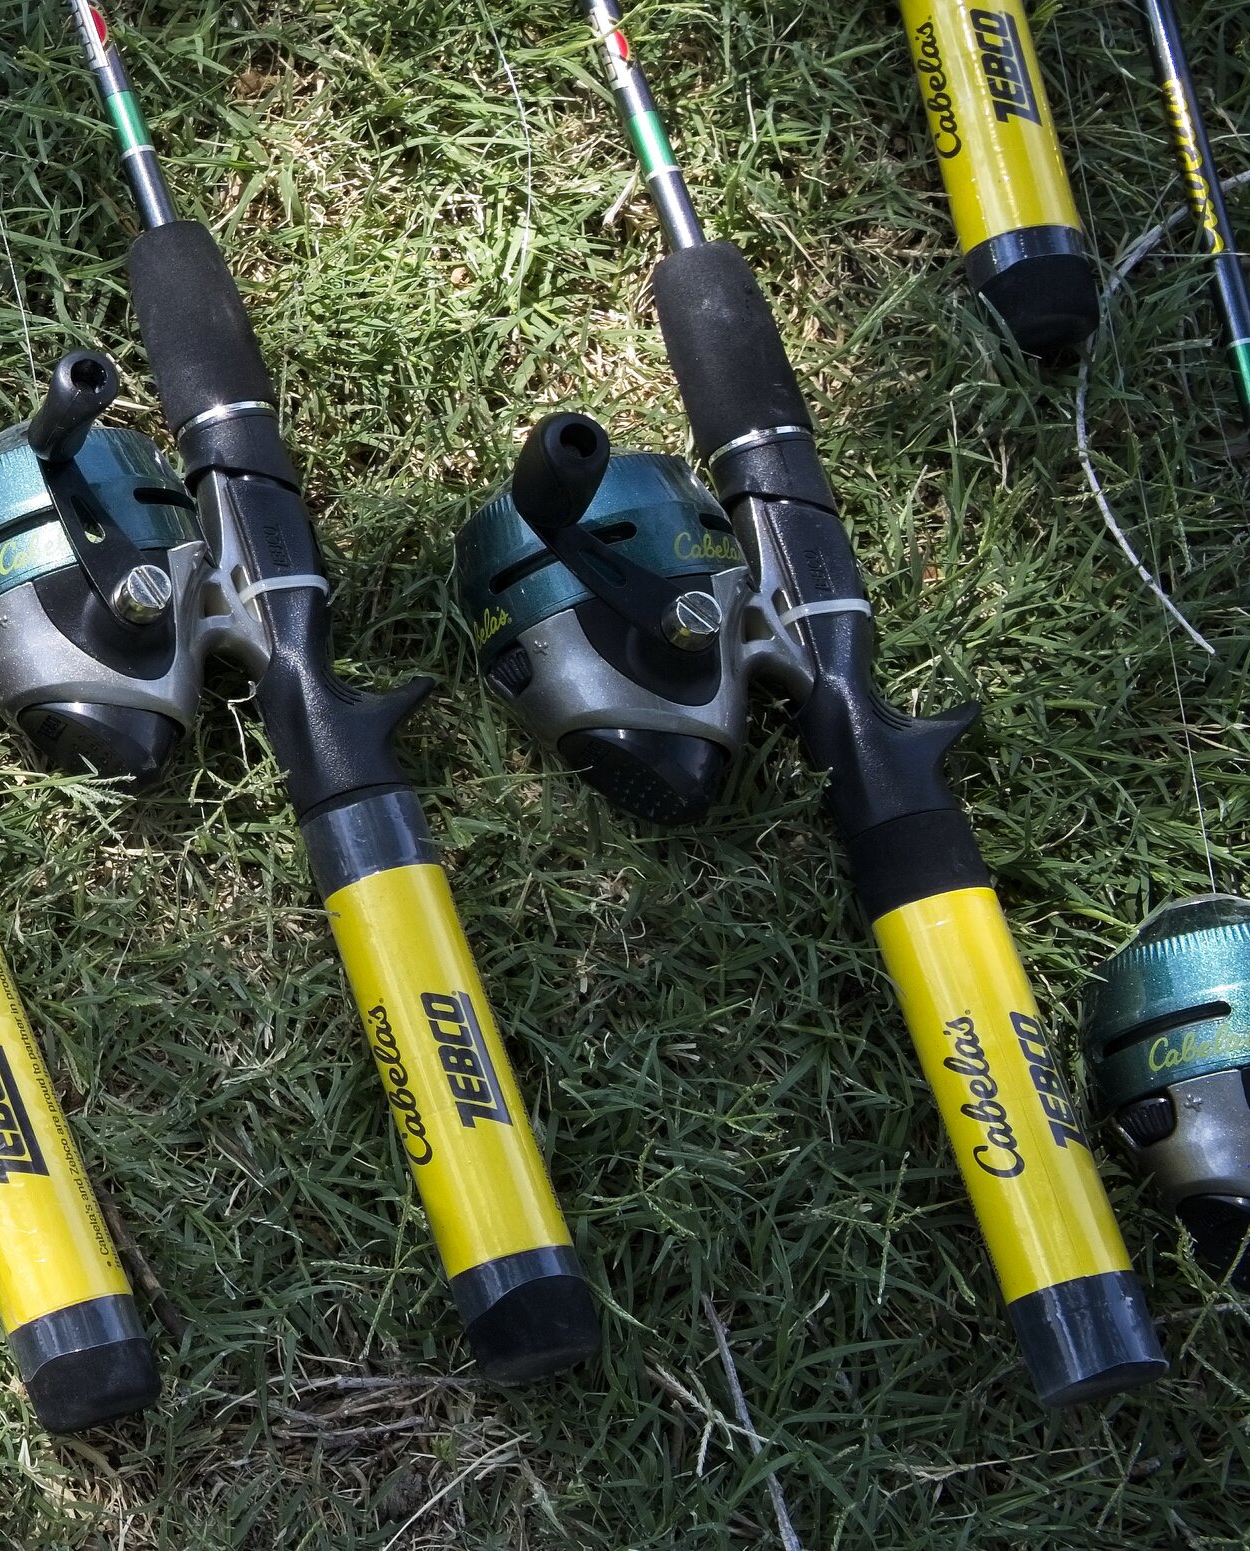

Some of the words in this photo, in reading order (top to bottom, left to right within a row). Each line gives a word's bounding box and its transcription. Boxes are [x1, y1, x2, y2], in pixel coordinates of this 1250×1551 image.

[970, 8, 1043, 127] ZEBCO
[915, 22, 962, 159] Cabela's
[9, 1003, 18, 1015] in
[13, 1017, 37, 1061] partner
[420, 991, 513, 1128] ZEBCO
[31, 1062, 41, 1075] to
[368, 1005, 433, 1166] Cabela's
[1009, 1011, 1091, 1151] ZEBCO
[36, 1078, 57, 1113] proud
[943, 1016, 1025, 1178] Cabela's
[51, 1115, 64, 1135] are
[60, 1138, 79, 1175] Zebco
[73, 1178, 89, 1201] and
